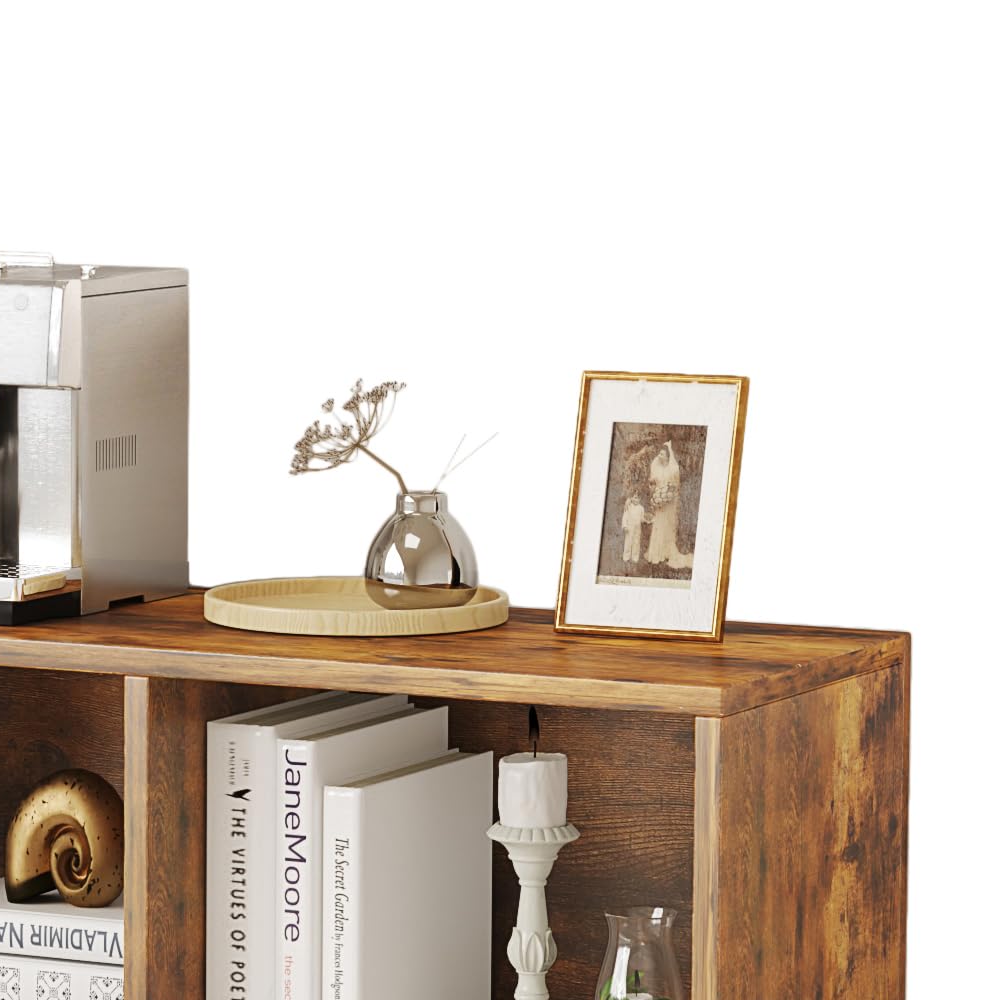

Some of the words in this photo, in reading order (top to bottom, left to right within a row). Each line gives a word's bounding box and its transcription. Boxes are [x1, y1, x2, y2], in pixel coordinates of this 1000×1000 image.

[231, 807, 246, 838] THE
[284, 748, 307, 942] JaneMoore
[334, 837, 349, 857] The
[231, 848, 246, 920] VIRTUES
[334, 859, 349, 890] Secret
[334, 893, 349, 932] Garden
[231, 930, 246, 951] OF
[333, 943, 343, 968] Frances
[284, 955, 293, 977] the
[331, 969, 344, 1000] Hodgson
